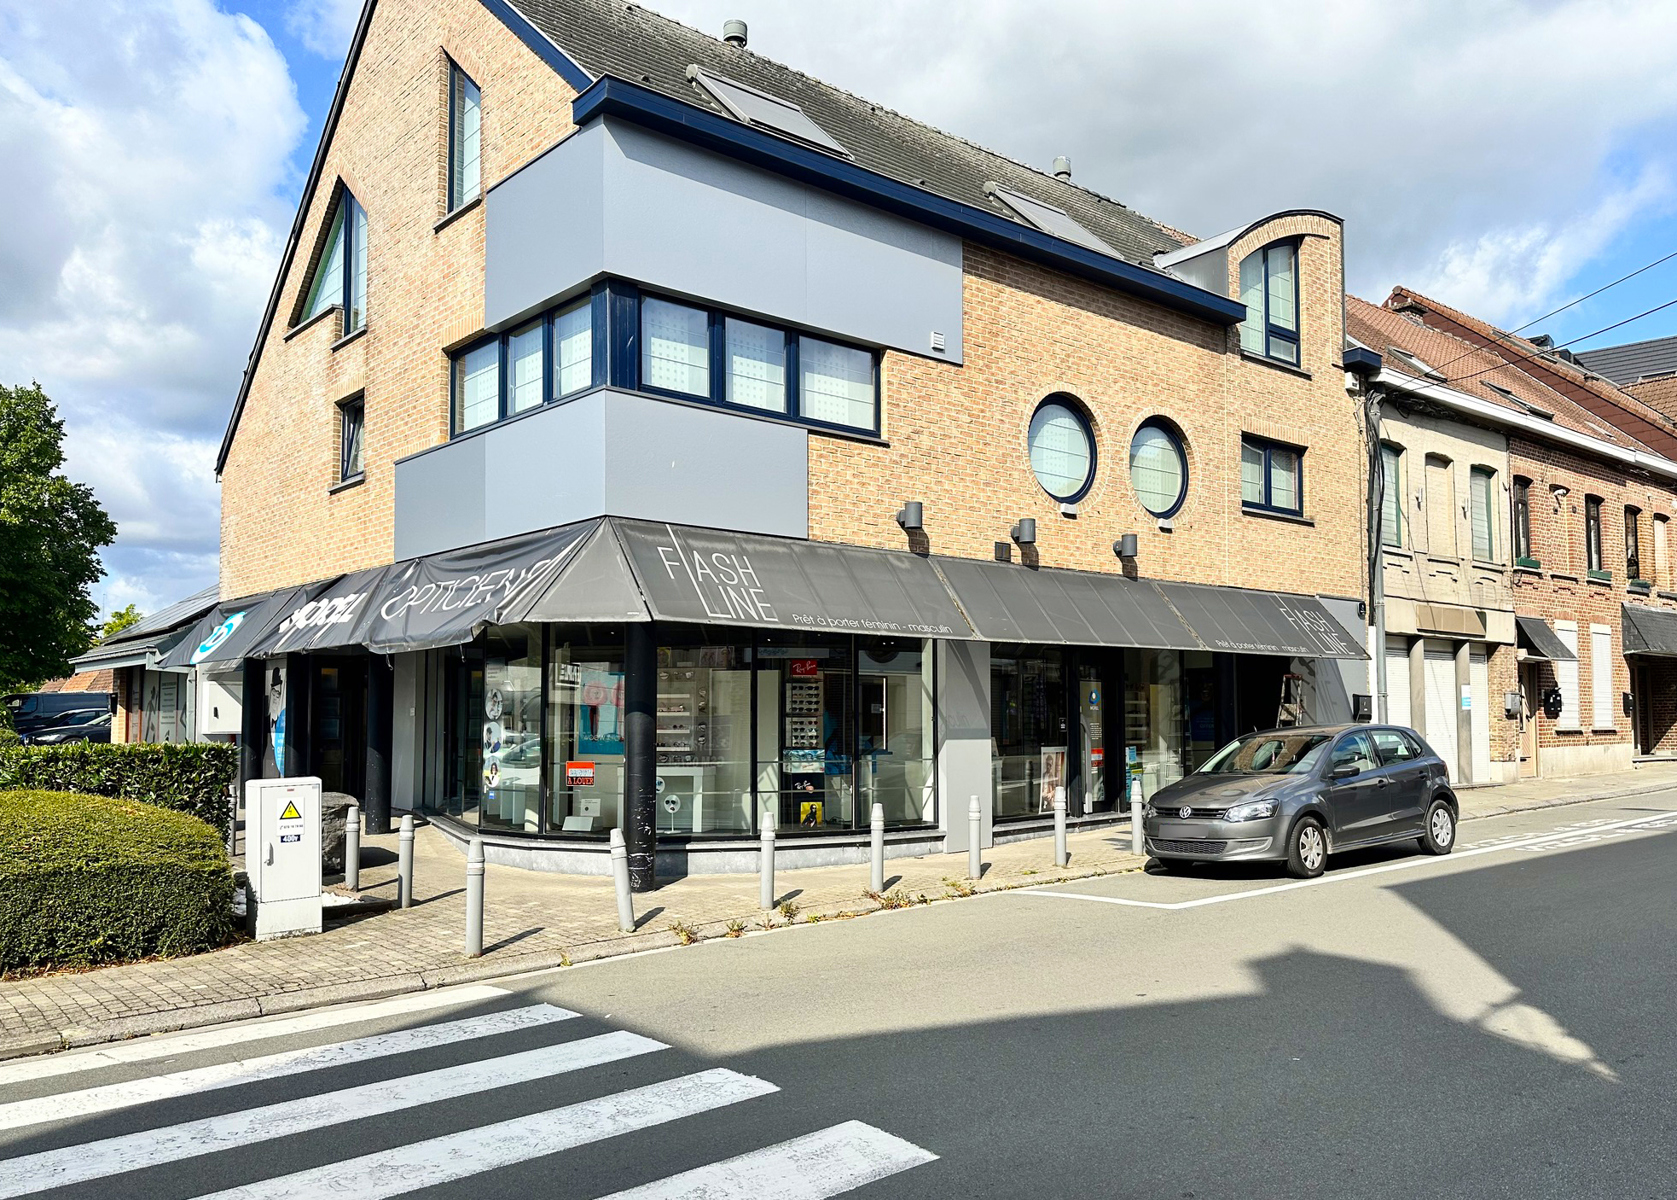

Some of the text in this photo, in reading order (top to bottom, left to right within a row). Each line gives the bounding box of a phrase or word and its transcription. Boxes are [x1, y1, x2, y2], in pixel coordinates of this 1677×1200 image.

[657, 524, 761, 588] FLASH
[700, 585, 779, 622] LINE
[1274, 593, 1335, 632] FLASH
[792, 613, 815, 625] Prêt
[816, 615, 826, 625] à
[828, 618, 860, 628] porter
[861, 618, 901, 631] féminin
[908, 624, 953, 634] masculin
[1308, 632, 1356, 655] LINE
